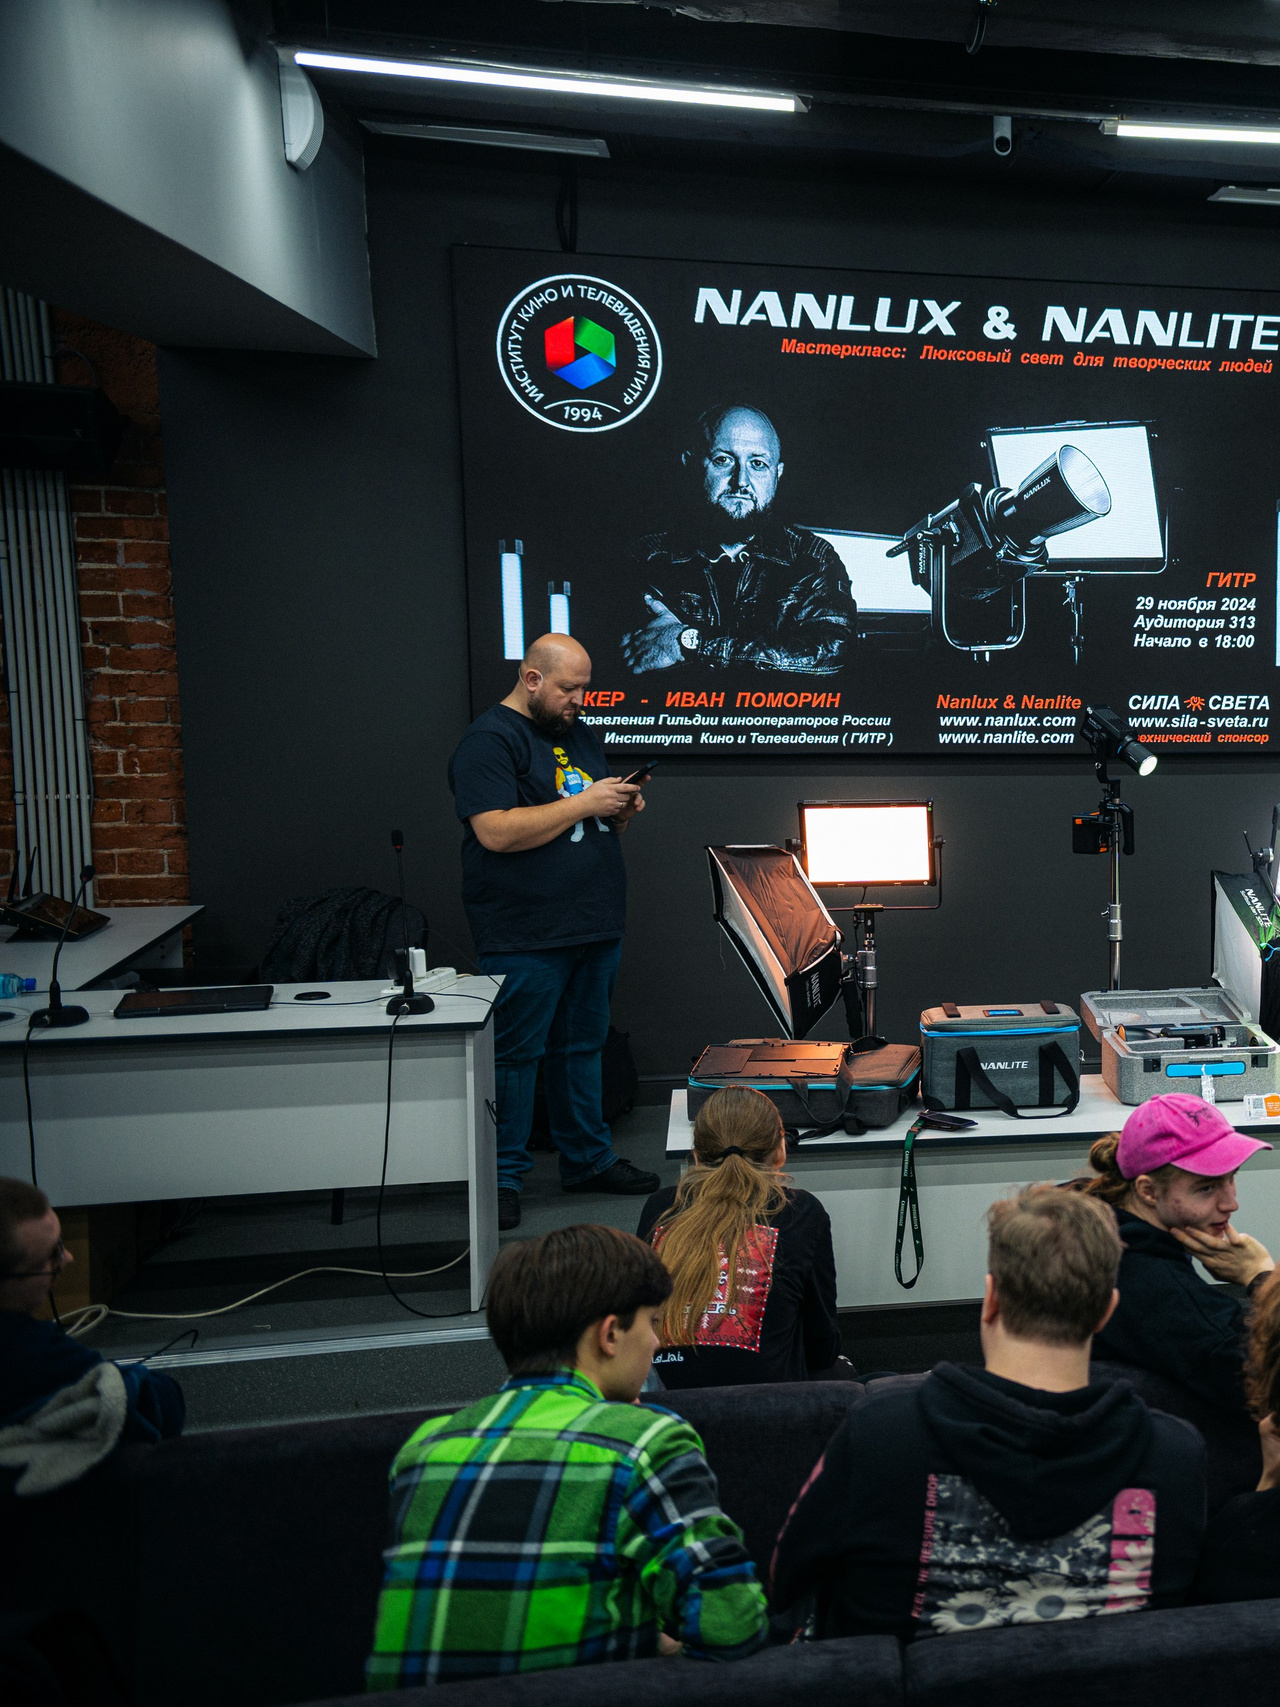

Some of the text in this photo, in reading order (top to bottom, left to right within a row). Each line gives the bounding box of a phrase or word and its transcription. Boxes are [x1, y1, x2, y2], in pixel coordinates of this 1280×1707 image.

[694, 288, 961, 336] NANLUX
[983, 306, 1017, 340] &
[508, 284, 651, 405] ИНСТИТУТ КИНО И ТЕЛЕВИДЕНИЯ ГИТР
[781, 339, 1273, 373] Мастеркласс: Люксовый свет для творческих людей
[564, 404, 604, 422] 1994
[1206, 572, 1256, 587] ГИТР
[1136, 596, 1256, 613] 29 ноября 2024
[1133, 614, 1255, 631] Аудитория 313
[1134, 634, 1255, 648] Начало в 18:00
[583, 691, 625, 707] КЕР
[666, 692, 725, 707] ИВАН
[736, 692, 841, 707] ПОМОРИН
[937, 695, 1081, 709] Nanlux & Nanlite
[1128, 695, 1269, 710] СИЛА СВЕТА
[658, 714, 718, 725] Гильдии
[722, 717, 838, 728] кинооператоров
[842, 715, 891, 726] России
[940, 713, 1076, 726] www.nanlux.com
[1128, 714, 1268, 728] www.sila-sveta.ru
[604, 732, 692, 746] Института
[700, 732, 734, 743] Кино
[737, 735, 746, 743] и
[750, 732, 839, 743] Телевидения
[939, 730, 1074, 743] www.nanlite.com
[1138, 732, 1269, 744] ехнический спонсор
[1245, 888, 1272, 928] NANLITE
[810, 971, 822, 1008] NANLITE
[980, 1060, 1029, 1070] NANLITE
